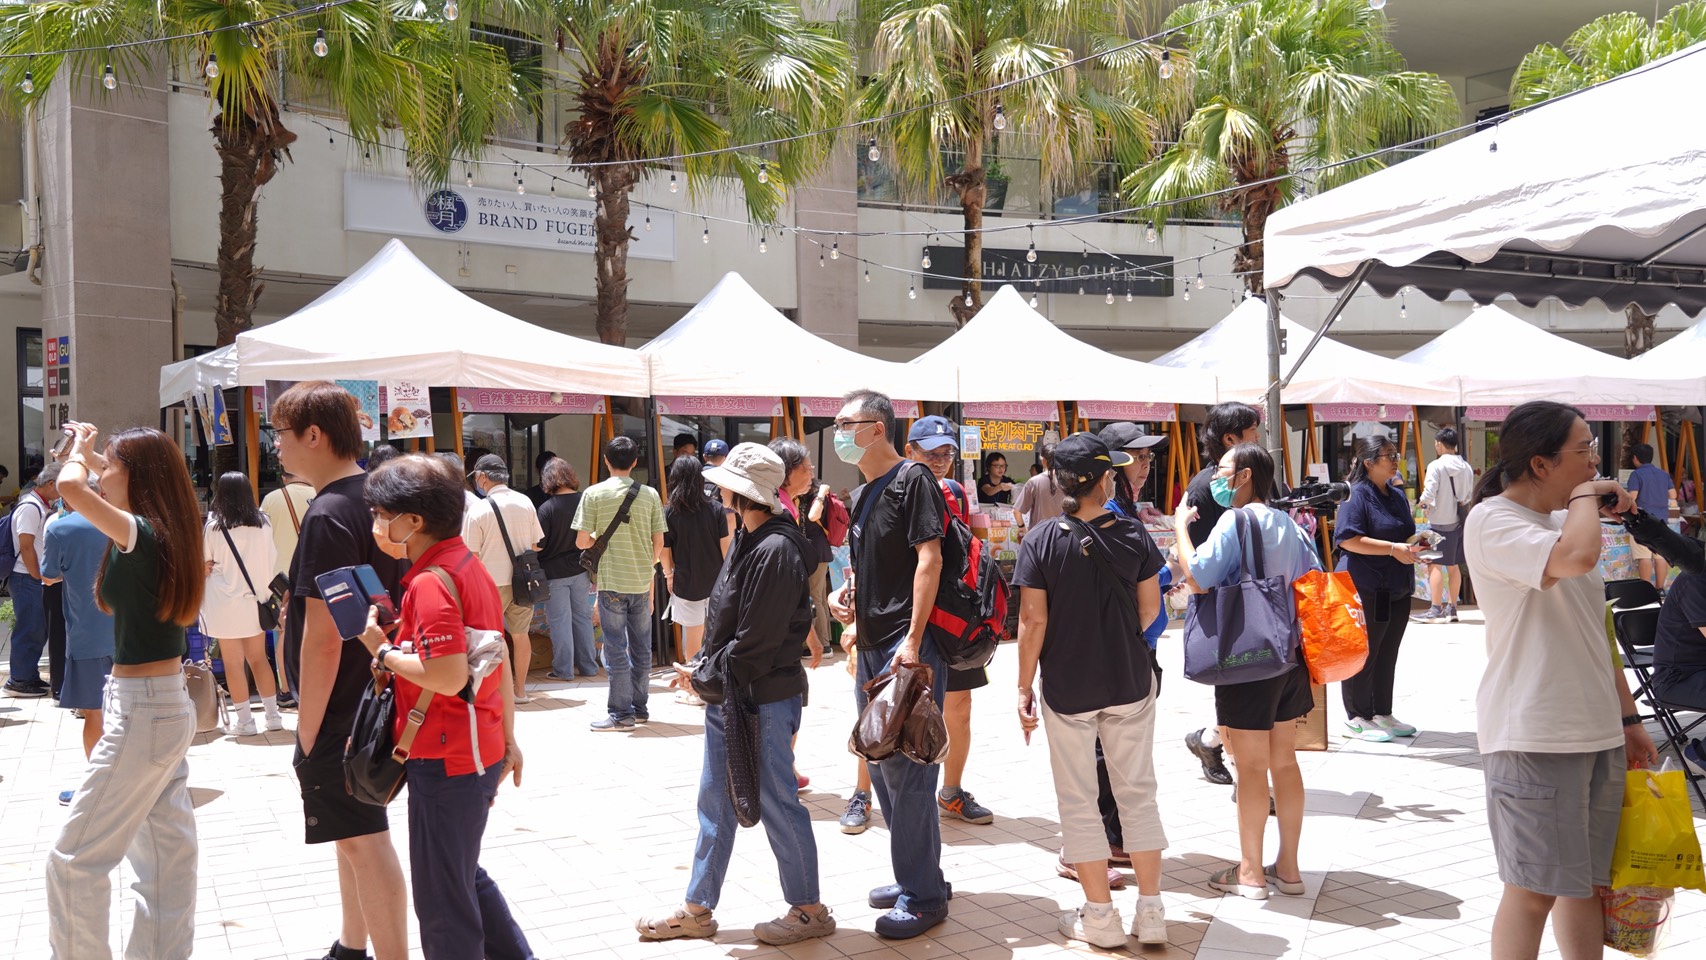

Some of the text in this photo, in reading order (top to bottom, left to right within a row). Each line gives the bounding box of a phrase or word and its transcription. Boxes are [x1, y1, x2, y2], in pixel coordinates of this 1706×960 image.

[478, 212, 597, 237] BRAND FUGET
[982, 261, 1137, 282] HIATZY CHEN
[59, 343, 69, 357] GU
[256, 402, 263, 410] 1
[461, 402, 467, 410] 2
[598, 404, 603, 412] 2
[659, 405, 664, 413] 3
[776, 407, 782, 415] 3
[998, 442, 1016, 450] MEAT
[1016, 443, 1034, 451] CURD
[989, 529, 1007, 538] $100
[1001, 551, 1015, 560] $70
